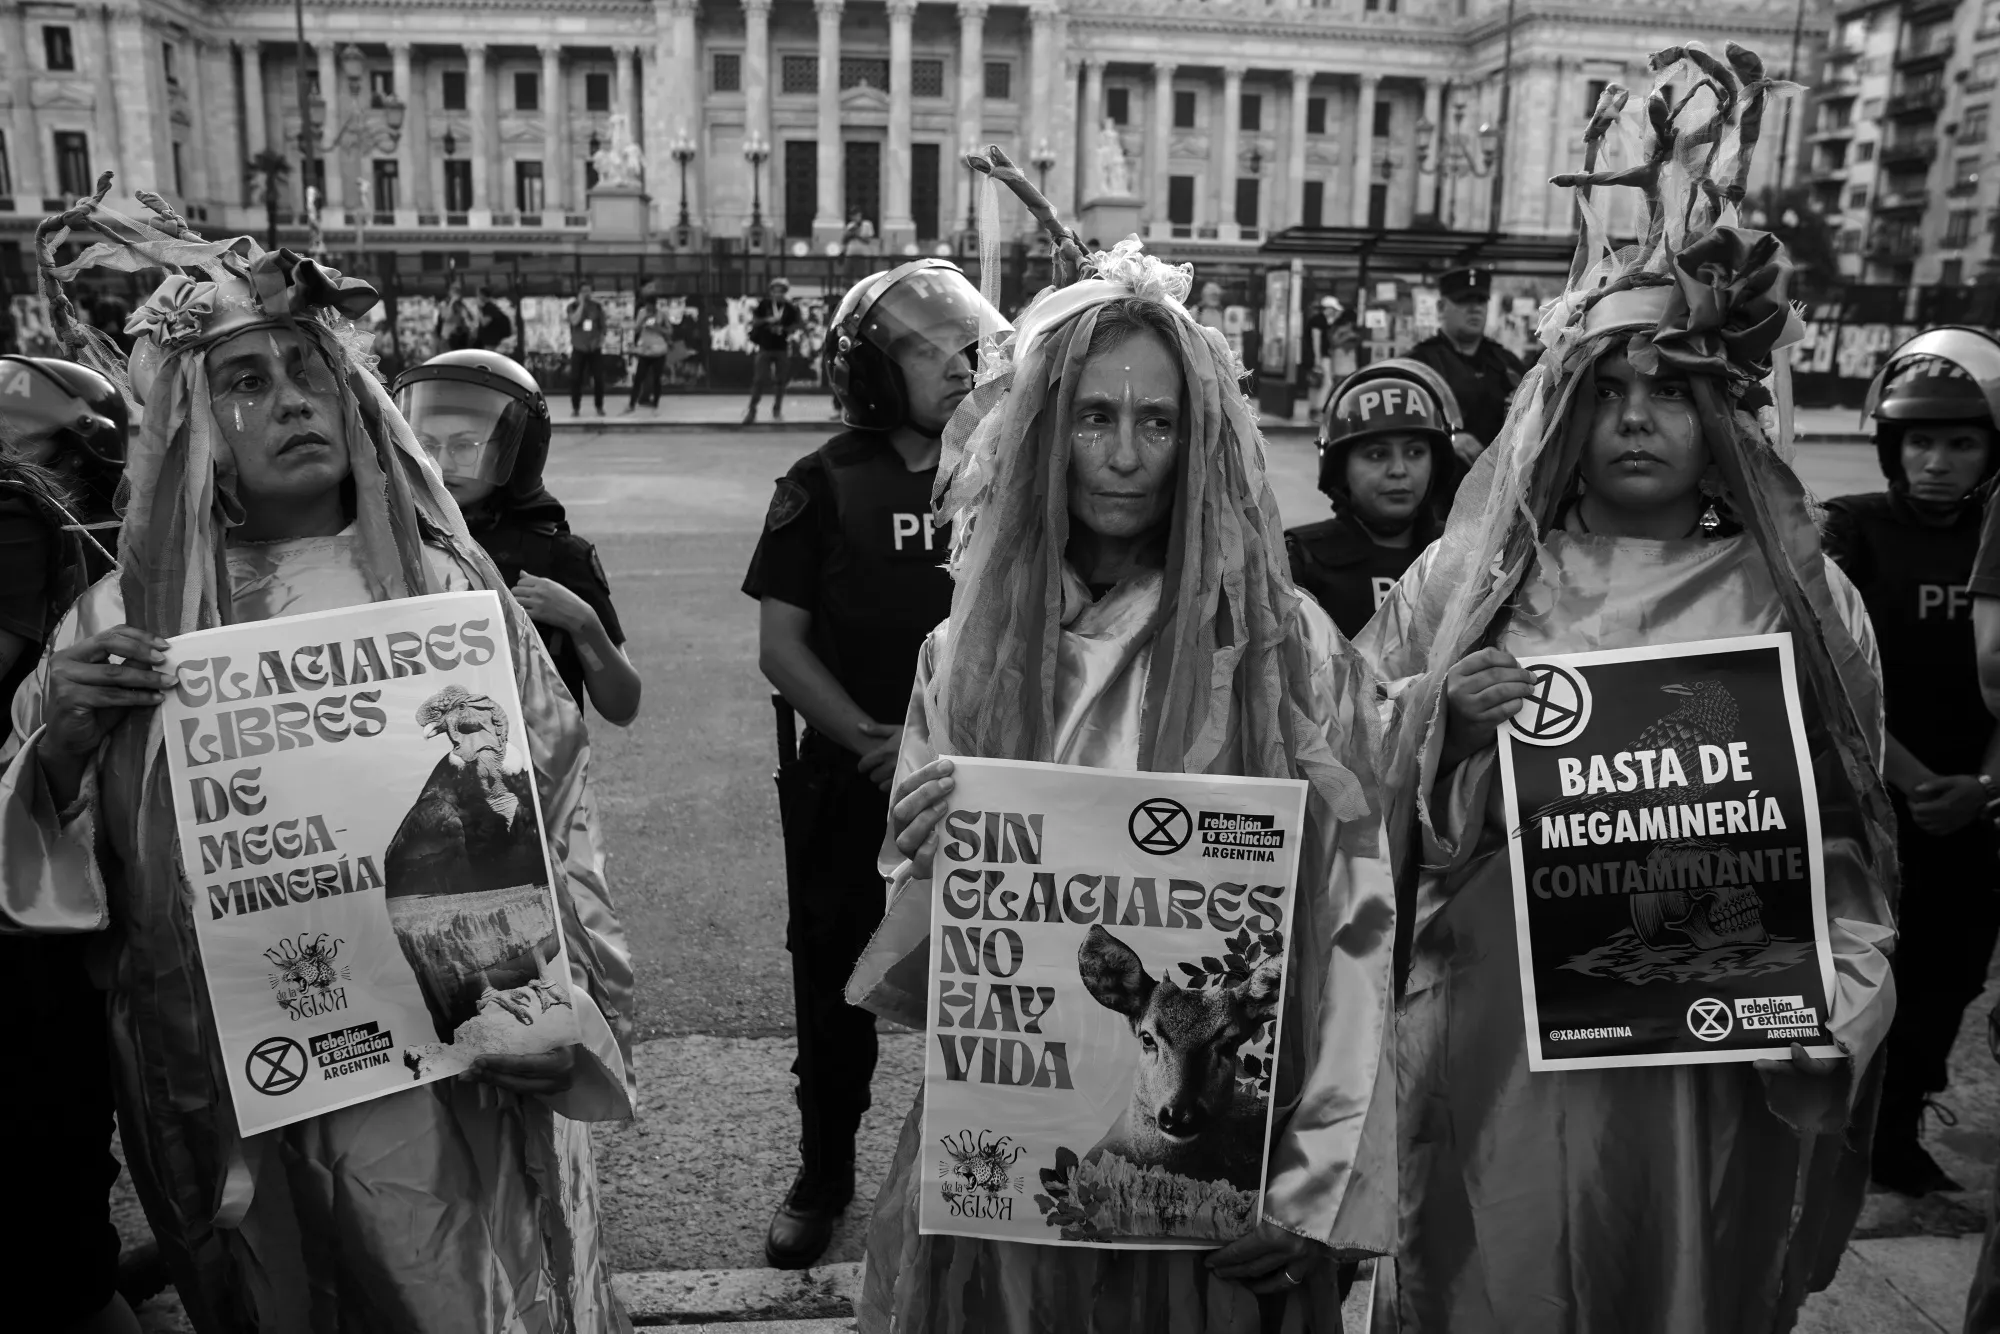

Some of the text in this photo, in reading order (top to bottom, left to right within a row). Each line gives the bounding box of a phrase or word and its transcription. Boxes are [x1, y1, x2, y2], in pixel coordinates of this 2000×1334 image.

[1358, 387, 1427, 421] PFA
[892, 512, 953, 551] PF
[1918, 584, 1975, 621] PF
[176, 618, 496, 708] GLACIARES
[179, 689, 388, 768] LIBRES
[1558, 741, 1753, 797] BASTA DE
[188, 766, 268, 826] DE
[943, 809, 1045, 865] SIN
[1204, 813, 1262, 831] rebelión
[1206, 830, 1281, 846] o extinción
[1541, 789, 1787, 849] MEGAMINERÍA
[198, 814, 348, 876] MEGA-
[1202, 846, 1275, 862] ARGENTINA
[206, 852, 386, 921] MINERÍA
[1532, 847, 1804, 900] CONTAMINANTE
[942, 868, 1286, 934] GLACIARES
[939, 925, 1024, 978] NO
[276, 987, 298, 1001] de la
[937, 979, 1056, 1035] HAY
[1740, 998, 1793, 1014] rebelión
[1549, 1026, 1633, 1042] @XRARGENTINA
[1746, 1010, 1815, 1027] o extinción
[1767, 1027, 1821, 1039] ARGENTINA
[315, 1028, 369, 1053] rebelión
[322, 1035, 391, 1064] o extinción
[324, 1052, 391, 1081] ARGENTINA
[936, 1033, 1075, 1090] VIDA
[941, 1180, 963, 1193] de la
